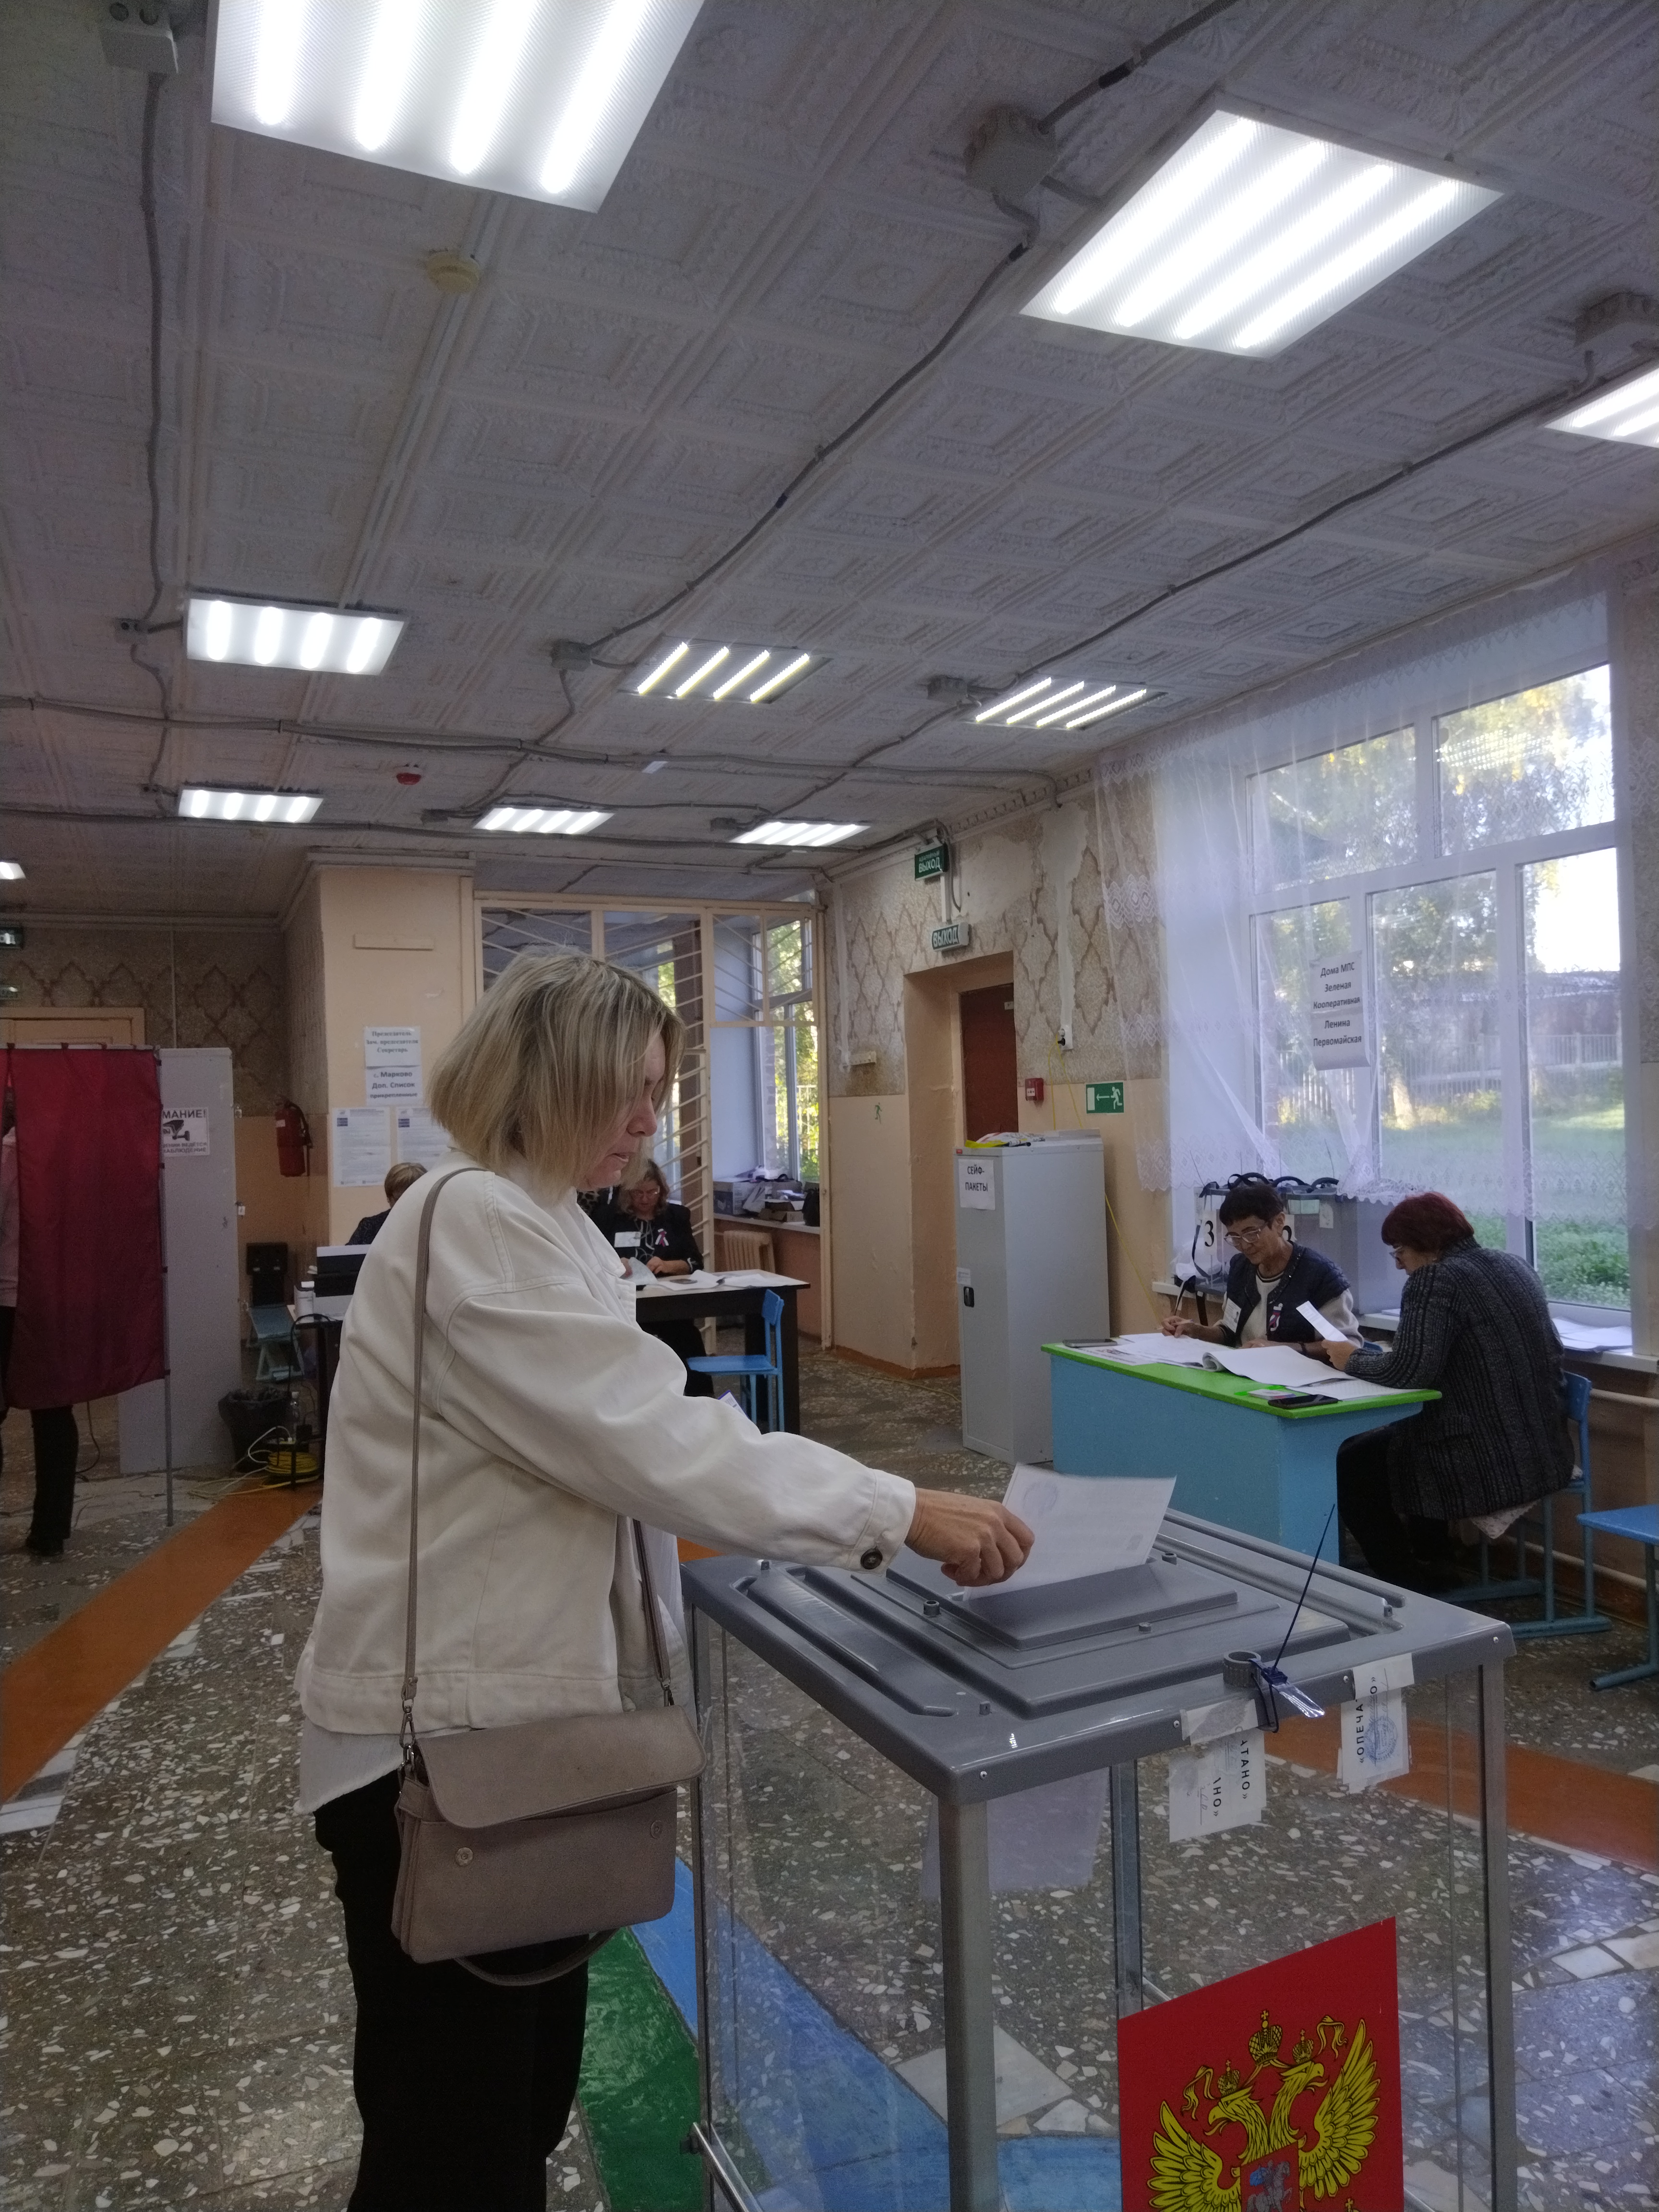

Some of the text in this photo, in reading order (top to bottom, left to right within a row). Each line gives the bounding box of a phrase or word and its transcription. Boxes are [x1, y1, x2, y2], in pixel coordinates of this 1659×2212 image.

[919, 857, 940, 873] ВЫХОД
[933, 927, 959, 947] ВЫХОД
[1320, 962, 1355, 978] Дома МПС
[1324, 982, 1351, 992] Зеленая
[1313, 997, 1360, 1009] Кооперативная
[1324, 1020, 1350, 1029] Ленина
[1313, 1035, 1362, 1048] Первомайская
[967, 1163, 985, 1175] СЕЙФ-
[965, 1182, 988, 1192] ПАКЕТЫ
[1355, 1699, 1365, 1764] «ОПЕЧА
